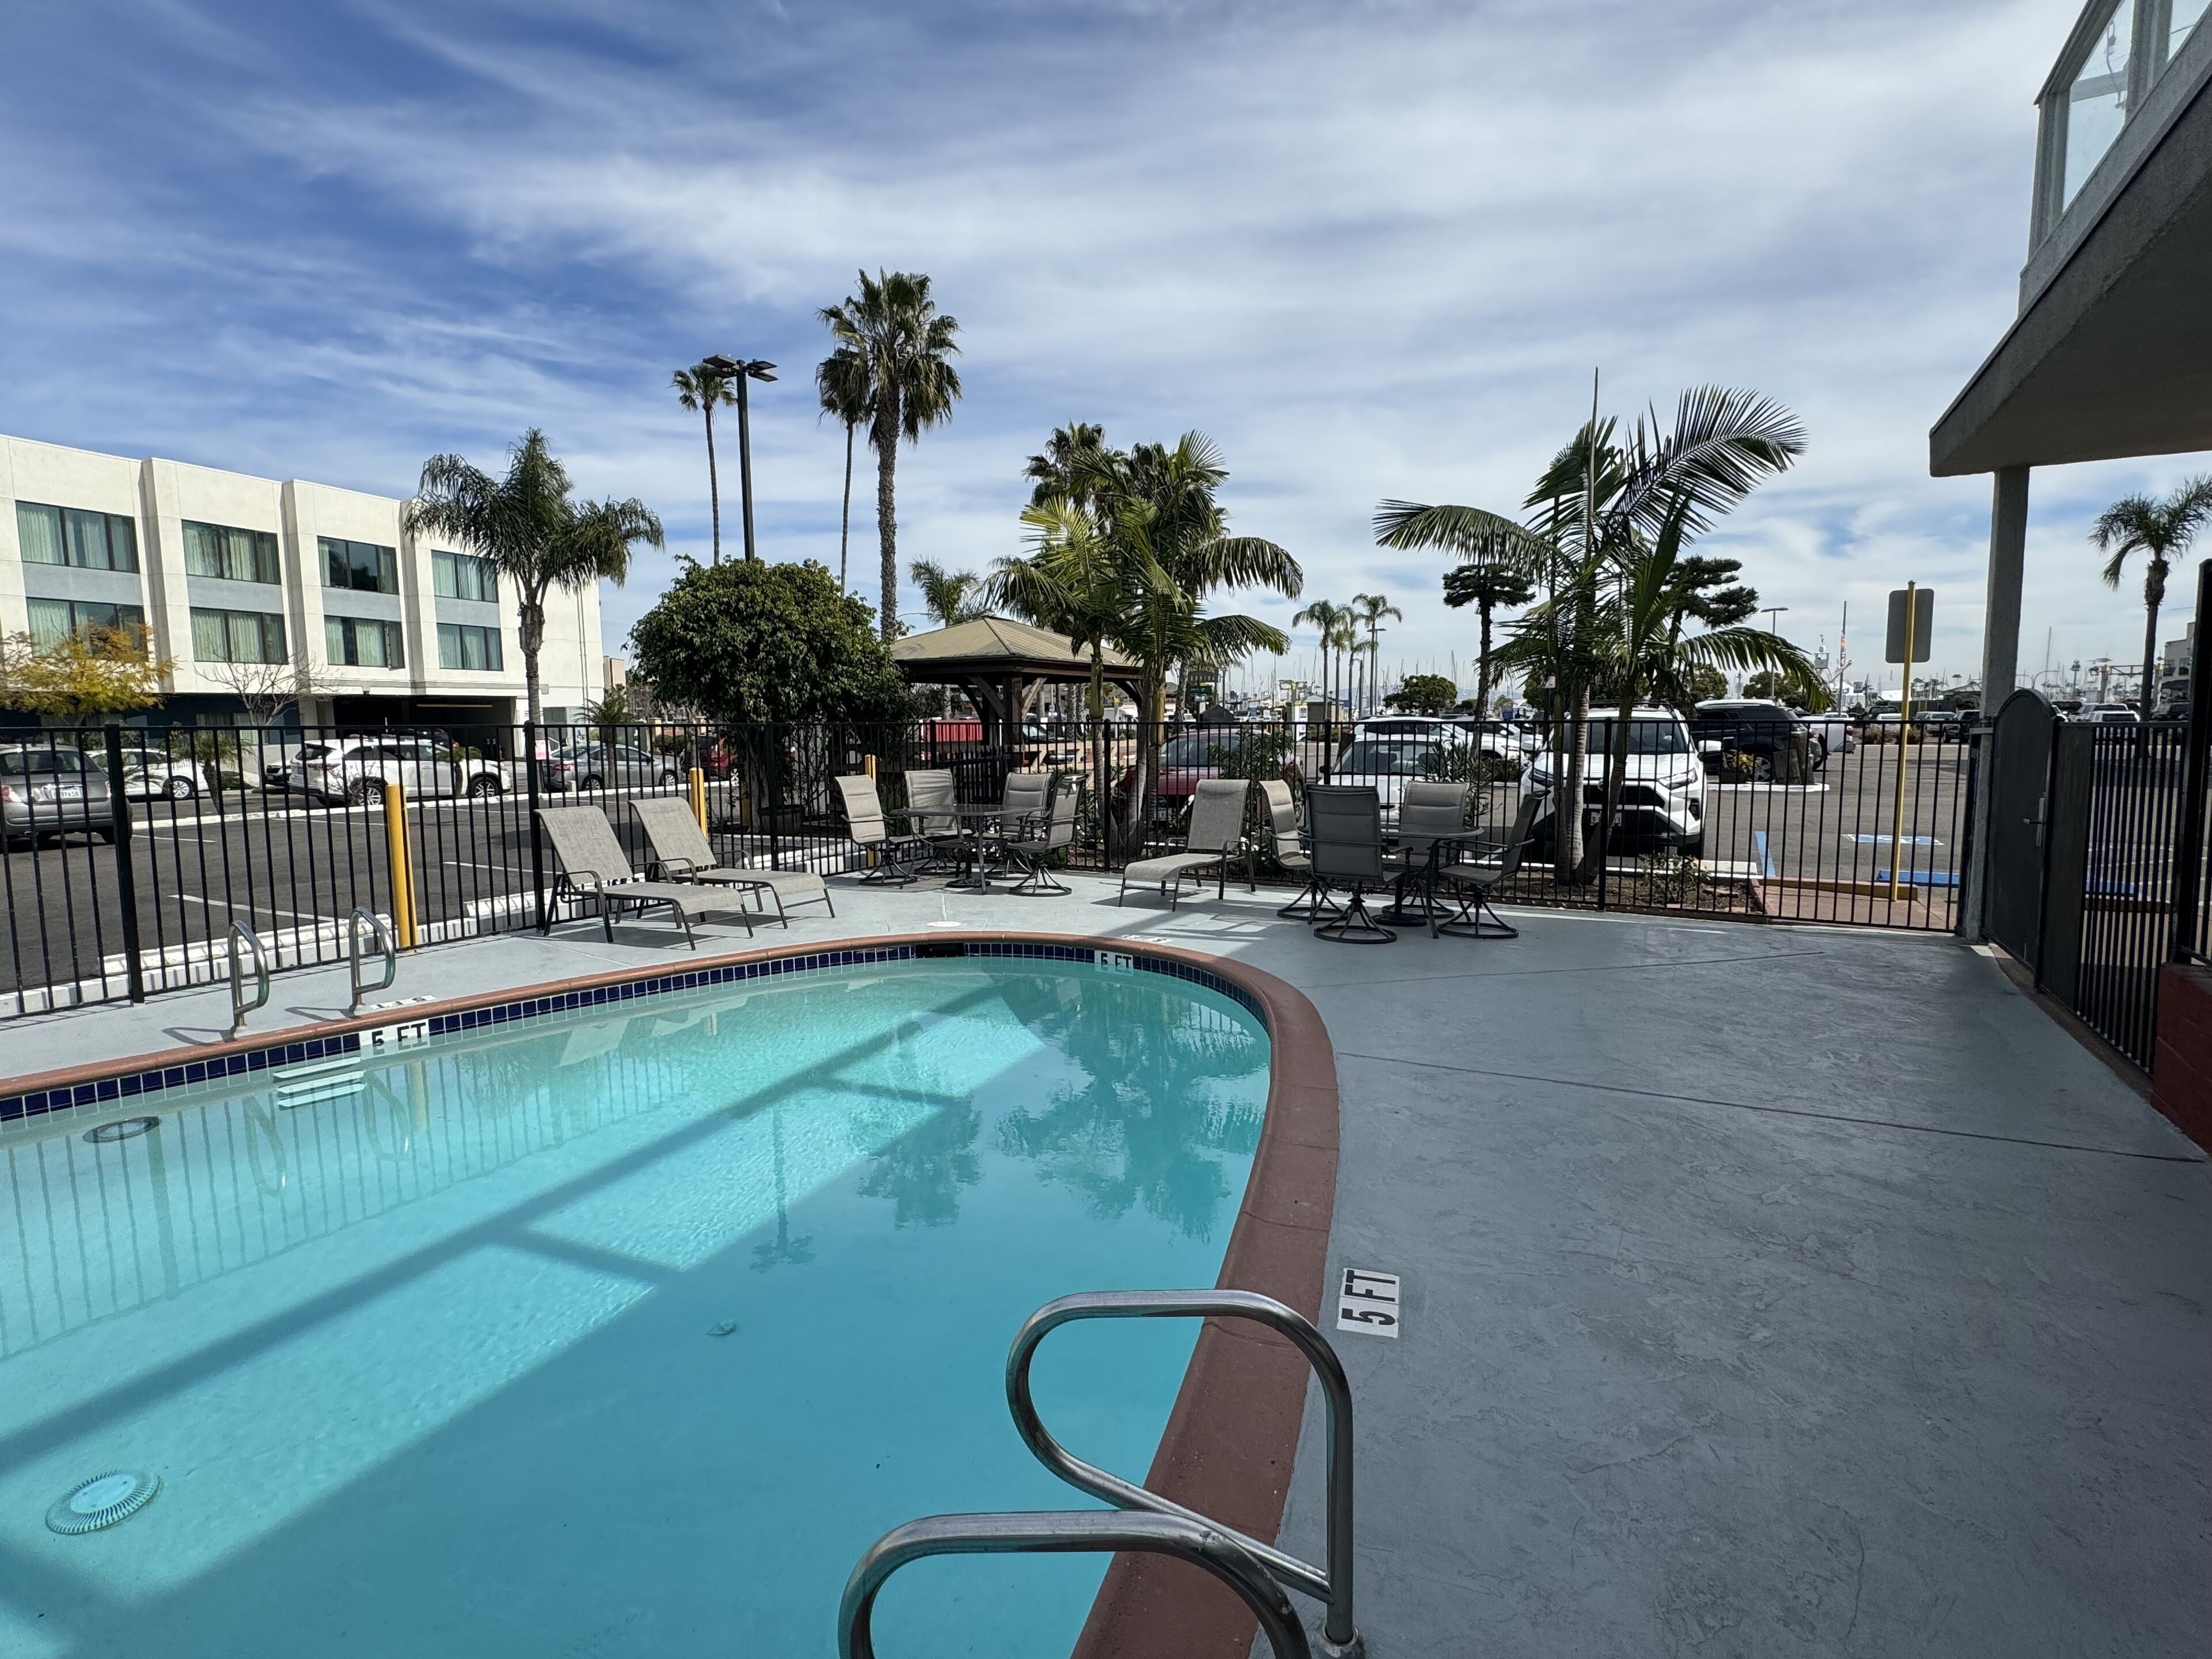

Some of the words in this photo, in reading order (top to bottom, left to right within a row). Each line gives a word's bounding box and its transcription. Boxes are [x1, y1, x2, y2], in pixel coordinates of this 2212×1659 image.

[1101, 952, 1108, 965] 5
[1115, 955, 1132, 968] FT
[372, 1029, 385, 1046] 5
[397, 1022, 426, 1043] FT
[1344, 1269, 1396, 1302] FT
[1341, 1308, 1396, 1325] 5
